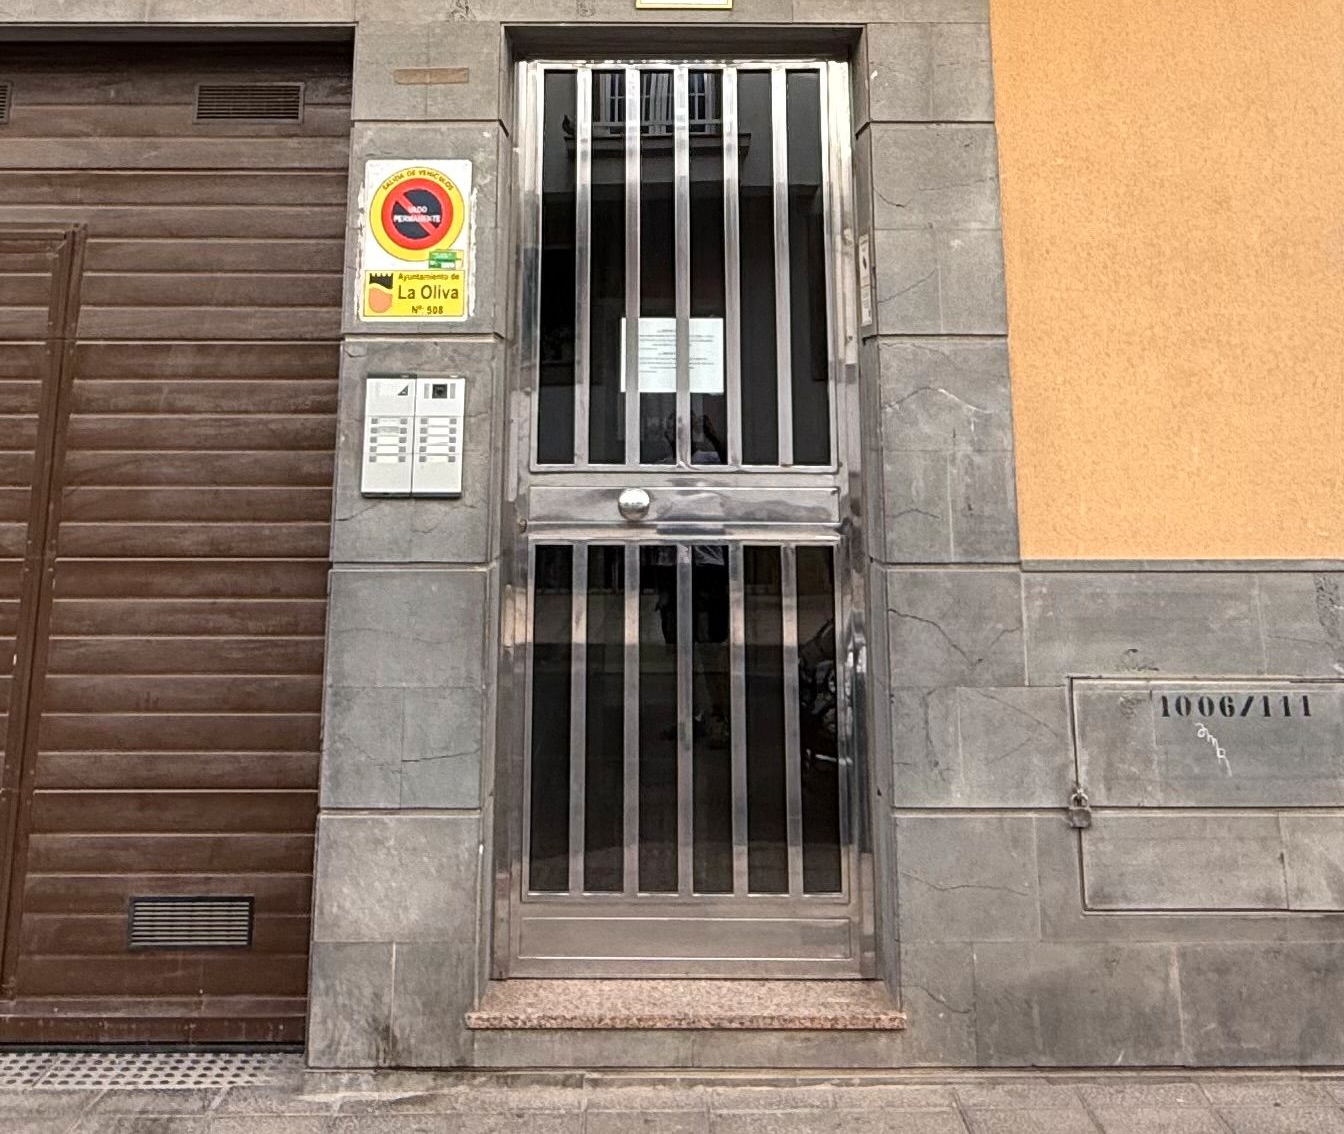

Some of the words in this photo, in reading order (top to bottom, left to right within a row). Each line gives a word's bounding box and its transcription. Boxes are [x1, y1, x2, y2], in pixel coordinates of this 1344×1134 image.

[393, 214, 441, 223] PERMANENTE
[398, 272, 449, 282] Ayuntamiento
[450, 272, 460, 281] de
[398, 285, 416, 300] La
[420, 284, 459, 300] Oliva
[1161, 695, 1312, 717] 1006/111
